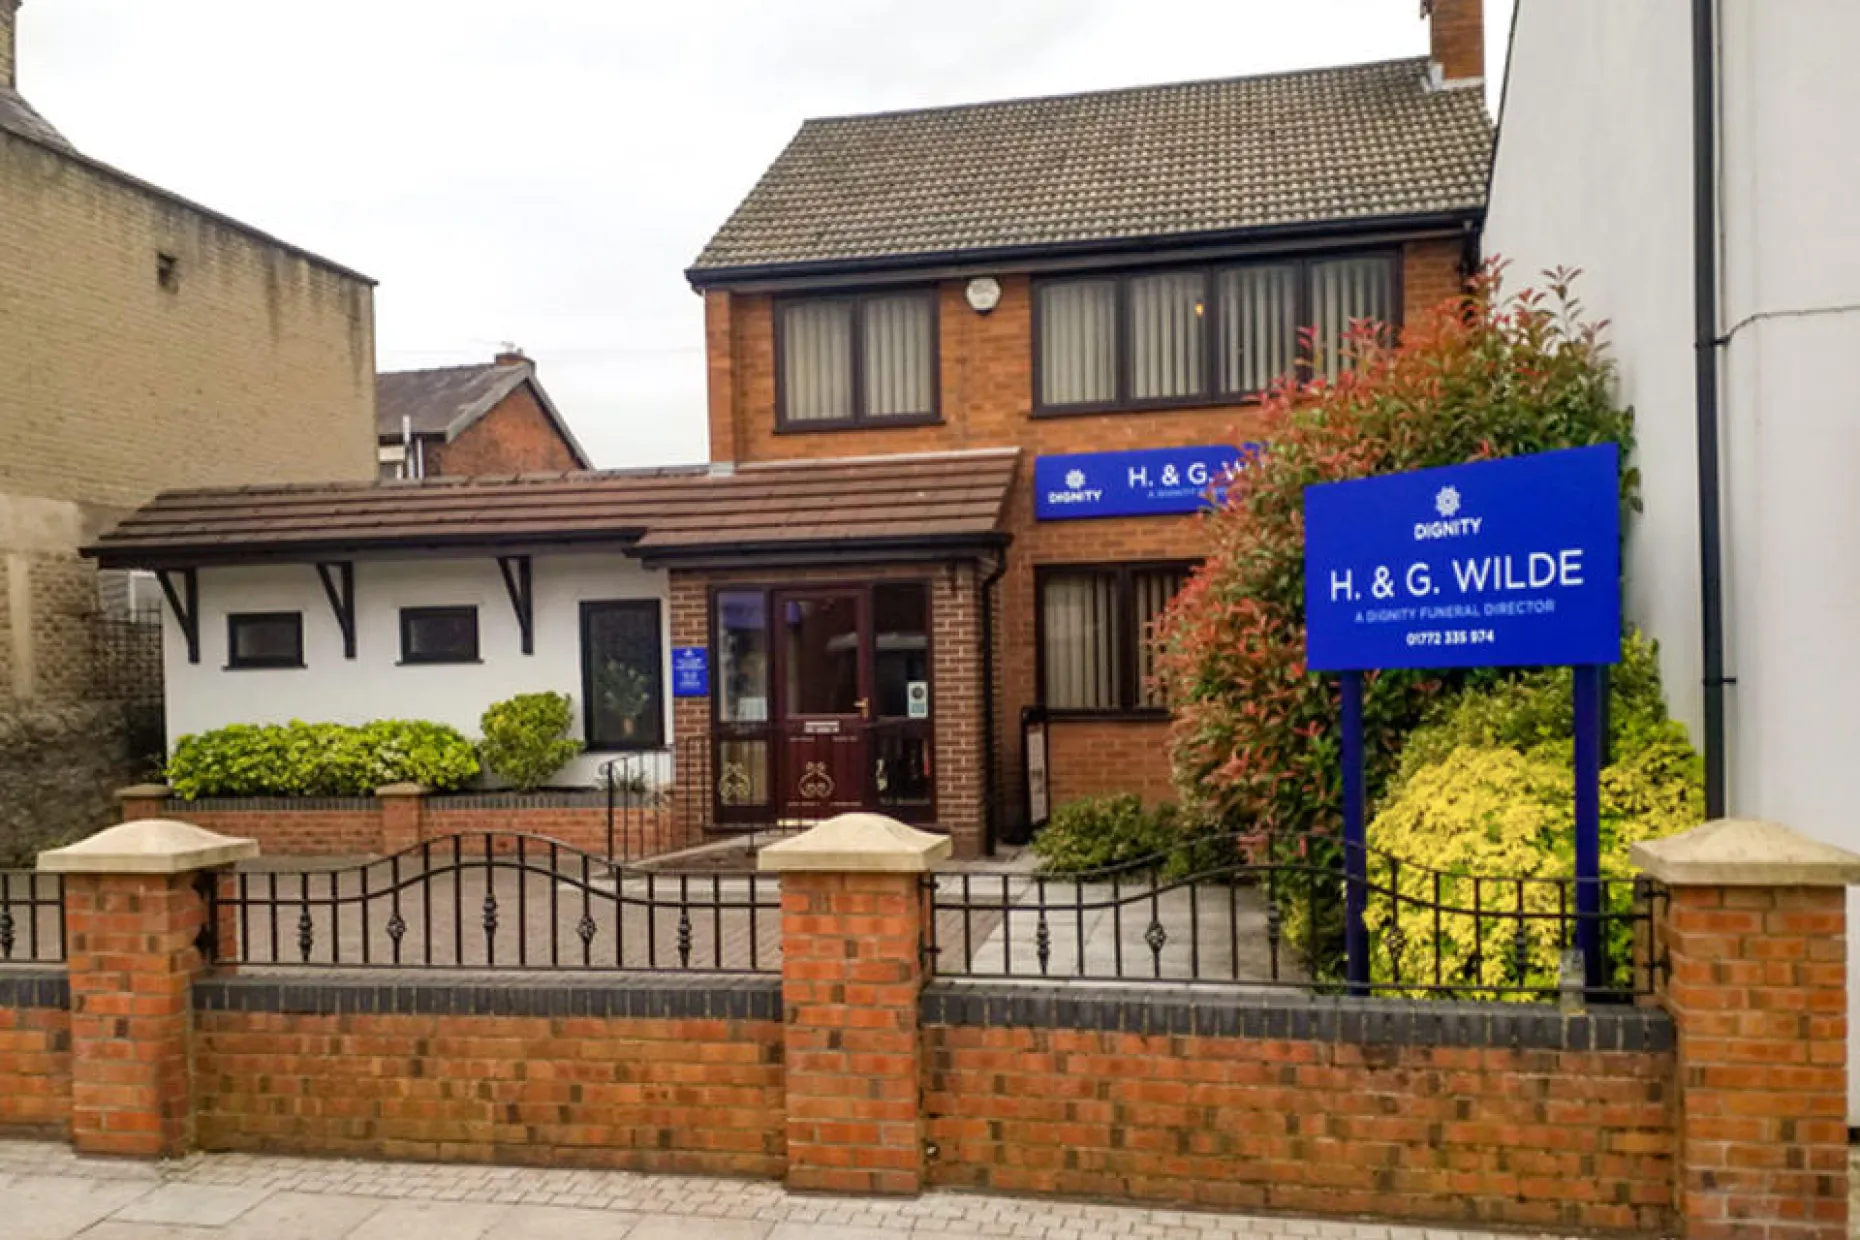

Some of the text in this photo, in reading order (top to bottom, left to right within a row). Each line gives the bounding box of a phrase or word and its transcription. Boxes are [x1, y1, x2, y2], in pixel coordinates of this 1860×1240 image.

[1128, 467, 1154, 488] H.
[1161, 464, 1179, 486] &
[1187, 462, 1214, 485] G.
[1048, 489, 1102, 504] DIGNITY
[1414, 517, 1482, 540] DIGNITY
[1330, 549, 1584, 602] H. & G. WILDE
[1355, 599, 1556, 623] A DIGNITY FUNERAL DIRECTOR
